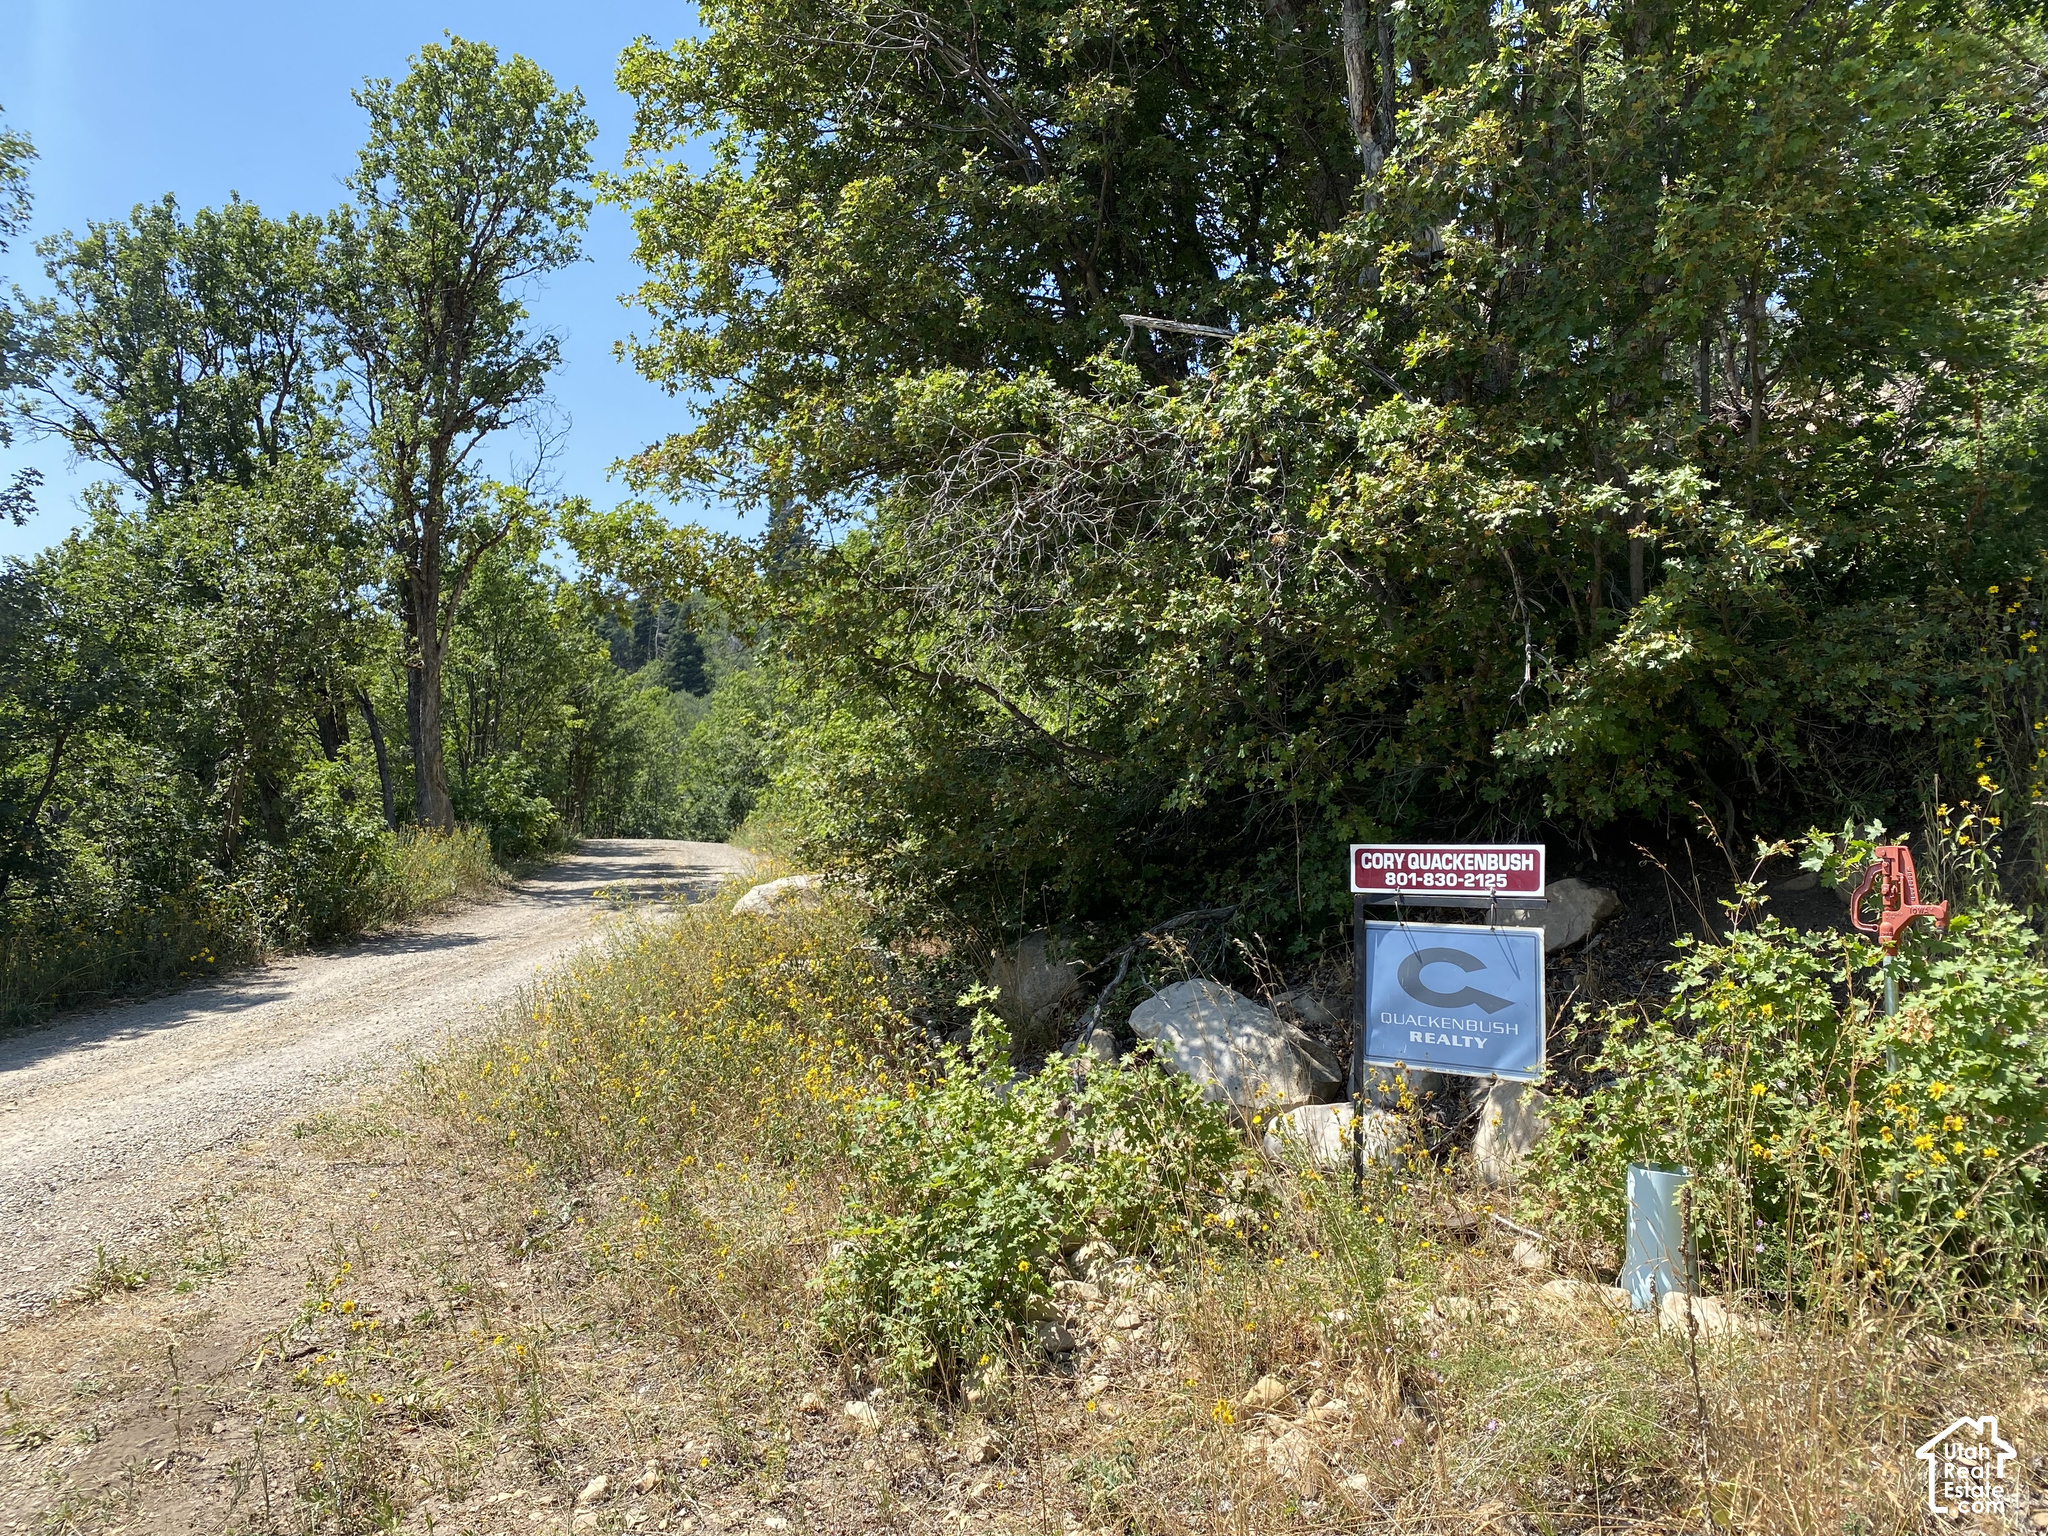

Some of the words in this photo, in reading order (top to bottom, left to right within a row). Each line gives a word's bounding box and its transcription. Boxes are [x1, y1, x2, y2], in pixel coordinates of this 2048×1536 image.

[1361, 852, 1405, 870] CORY
[1407, 853, 1534, 871] QUACKENBUSH
[1385, 872, 1508, 888] 801-830-2125
[1381, 1012, 1519, 1035] QUACKENBUSH
[1409, 1031, 1488, 1049] REALTY
